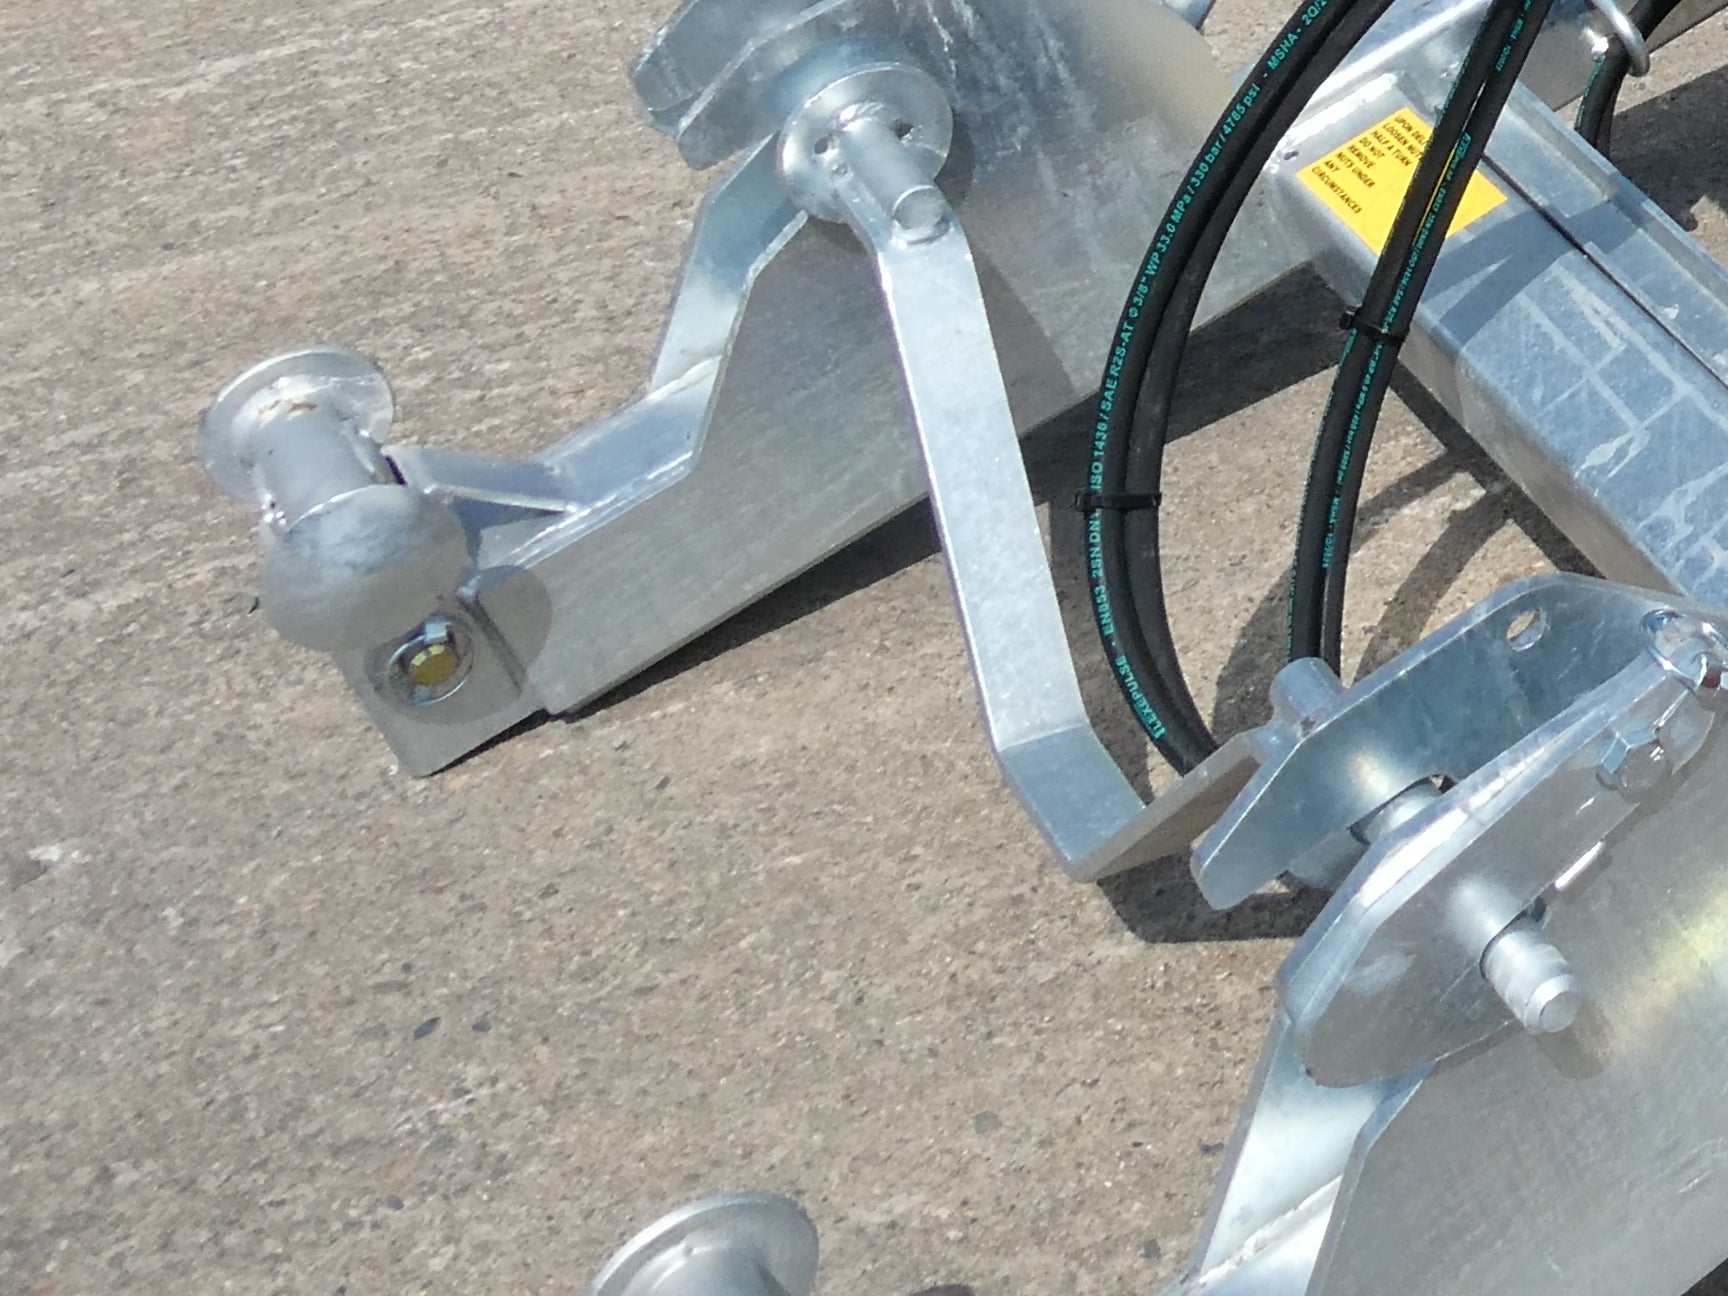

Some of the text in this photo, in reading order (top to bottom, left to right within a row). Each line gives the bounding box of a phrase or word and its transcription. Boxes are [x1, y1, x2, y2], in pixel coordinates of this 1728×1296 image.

[1267, 32, 1300, 71] MSHA
[1243, 83, 1261, 108] psi
[1222, 103, 1247, 136] 4785
[1383, 123, 1408, 146] LOOSEN
[1394, 116, 1413, 132] UPON
[1205, 138, 1223, 165] bar
[1349, 145, 1376, 169] REMOVE
[1358, 137, 1386, 159] DO NOT
[1370, 130, 1412, 167] HALF TURN
[1190, 161, 1210, 188] 330
[1324, 160, 1340, 173] ANY
[1336, 151, 1376, 189] NUTS UNDER
[1171, 188, 1193, 224] MPa
[1311, 166, 1362, 214] CIRCUMSTANCES
[1160, 222, 1177, 254] 33.0
[1145, 251, 1162, 276] WP
[1111, 321, 1136, 376] R2S-AT
[1100, 378, 1118, 412] SAE
[1092, 421, 1108, 457] 1436
[1090, 460, 1104, 492] ISO
[1089, 544, 1103, 578] 2SN
